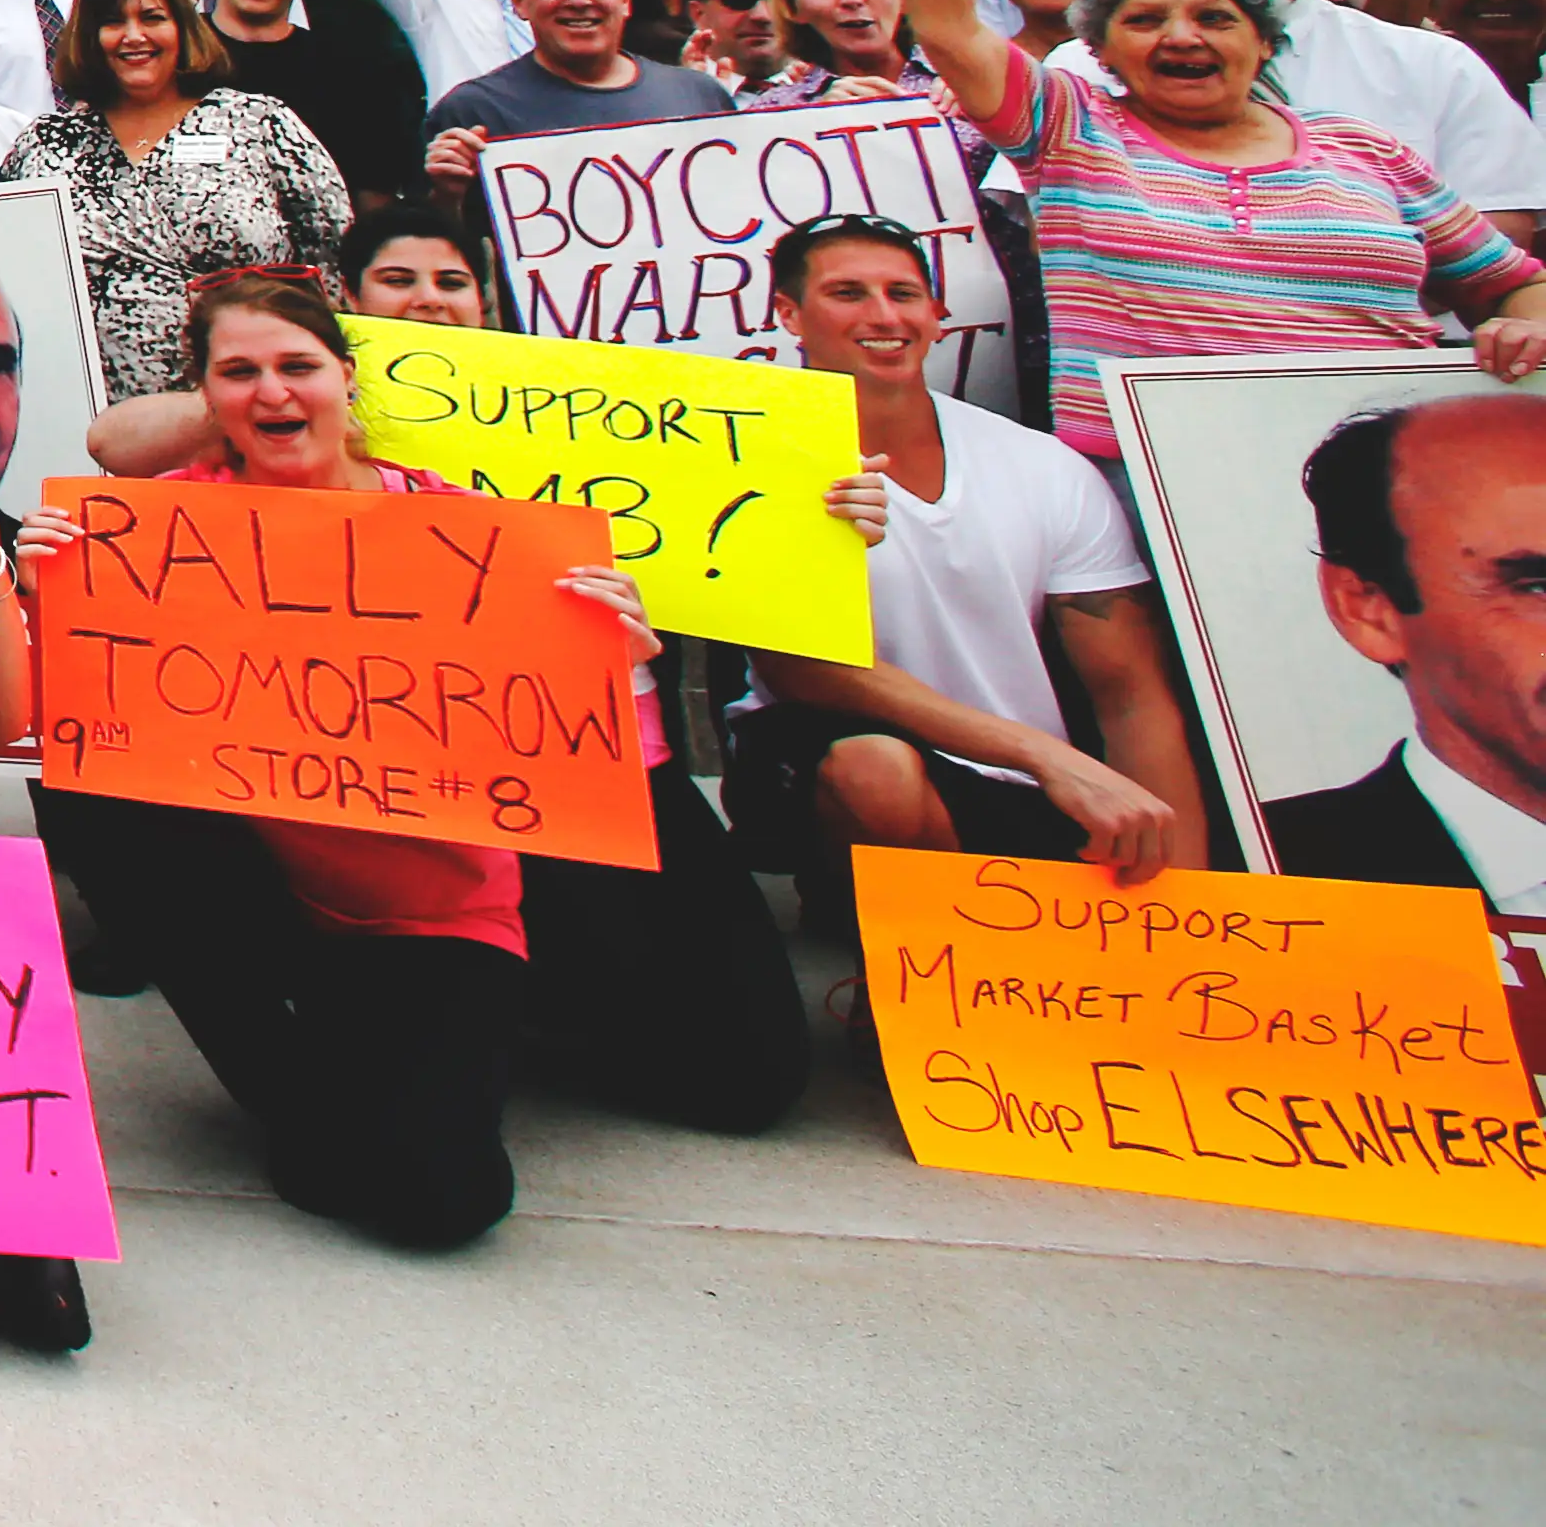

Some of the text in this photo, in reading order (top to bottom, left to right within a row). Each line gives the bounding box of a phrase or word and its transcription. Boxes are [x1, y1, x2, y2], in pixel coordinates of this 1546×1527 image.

[494, 117, 951, 261] BOYCOTT
[527, 225, 975, 344] MART
[78, 493, 503, 625] RALLY
[68, 627, 623, 762] TOMORROW
[212, 744, 427, 819] STORE
[923, 1049, 1546, 1181] Shop ELSEWHERE
